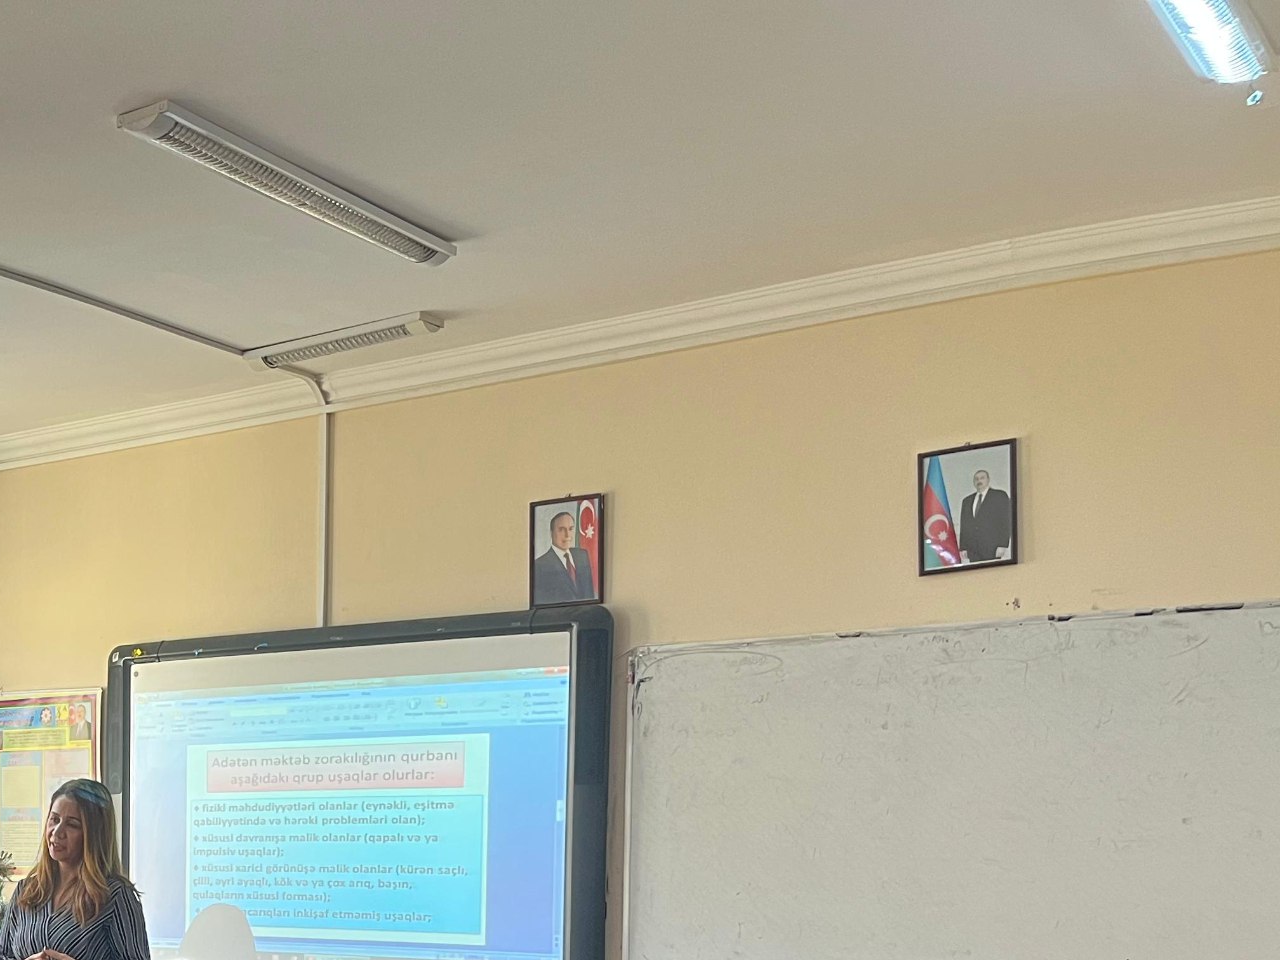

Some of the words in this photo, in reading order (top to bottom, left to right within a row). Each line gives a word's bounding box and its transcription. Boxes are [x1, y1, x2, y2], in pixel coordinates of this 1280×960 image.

[212, 756, 257, 769] Adətən
[261, 753, 311, 767] məktəb
[314, 752, 396, 766] zorakılığının
[401, 750, 458, 764] qurbanı
[231, 772, 289, 787] aşağıdakı
[292, 773, 324, 785] qrup
[328, 770, 379, 784] uşaqlar
[382, 768, 435, 782] olurlar:
[228, 801, 315, 814] məhdudiyyətləri
[318, 801, 358, 811] olanlar
[361, 800, 411, 813] (eynəkli,
[413, 799, 455, 812] eşitmə
[268, 818, 282, 826] və
[284, 815, 318, 825] hərəki
[321, 814, 388, 827] problemləri
[391, 814, 426, 827] olan);
[202, 832, 233, 843] xüsusi
[235, 832, 287, 845] davranışa
[288, 832, 320, 843] malik
[321, 832, 361, 843] olanlar
[363, 831, 404, 844] (qapalı
[407, 834, 421, 843] və
[424, 834, 439, 845] ya
[193, 847, 236, 858] impulsiv
[238, 846, 285, 858] uşaqlar);
[201, 863, 233, 873] xüsusi
[265, 863, 316, 876] görünüşə
[318, 863, 350, 874] malik
[352, 863, 393, 875] olanlar
[395, 863, 434, 876] (kürən
[437, 864, 469, 878] saçlı,
[274, 877, 293, 887] kök
[295, 878, 309, 887] və
[312, 879, 325, 889] ya
[348, 880, 375, 890] arıq,
[377, 879, 413, 891] başın,
[192, 890, 244, 901] qulaqların
[246, 891, 280, 901] xüsusi
[293, 908, 329, 920] inkişaf
[331, 910, 381, 922] etməmiş
[383, 911, 432, 924] uşaqlar;
